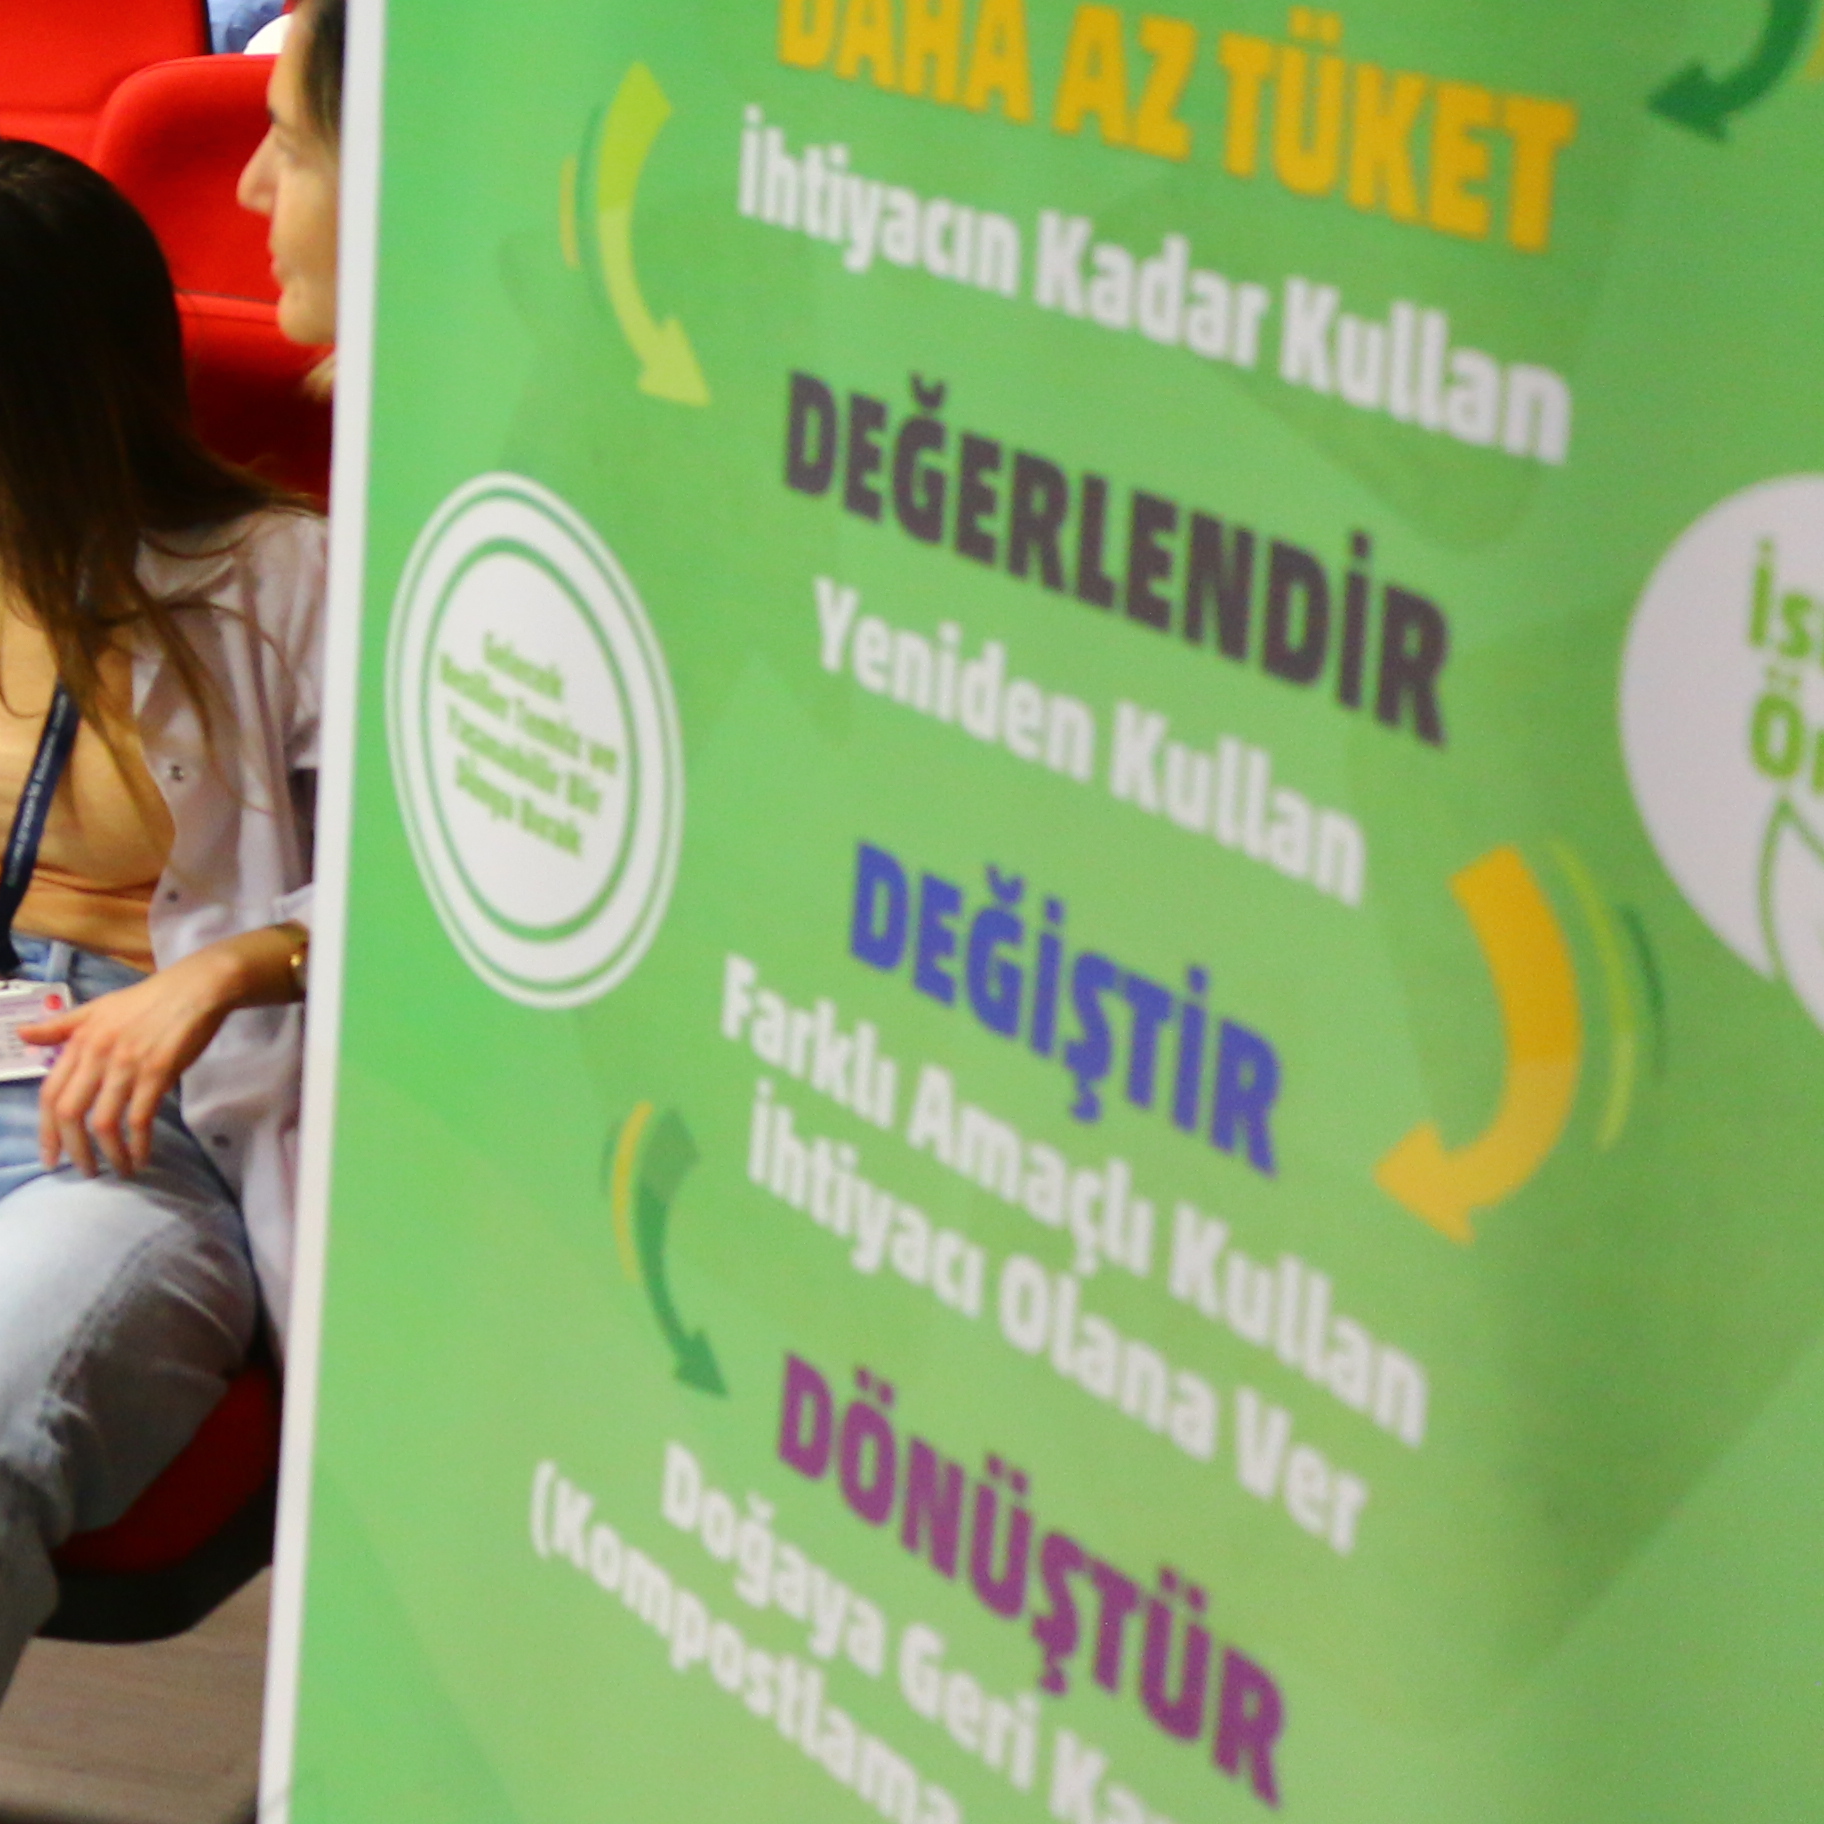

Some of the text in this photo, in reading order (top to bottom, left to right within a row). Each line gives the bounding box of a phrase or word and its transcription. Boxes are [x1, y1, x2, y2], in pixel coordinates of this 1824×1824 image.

[736, 102, 1571, 467] İhtiyacın Kadar Kullan
[1052, 0, 1200, 161] AZ
[1217, 4, 1581, 254] TÜKET
[782, 366, 1450, 751] DEĞERLENDİR
[811, 572, 1097, 785] Yeniden
[1106, 696, 1367, 908] Kullan
[849, 836, 1283, 1179] DEĞİŞTİR
[720, 950, 1428, 1450] Farklı Amaçlı Kullan
[747, 1077, 1368, 1559] İhtiyacı Olana Ver
[661, 1438, 885, 1678] Doğaya
[896, 1621, 1040, 1792] Geri
[776, 1348, 1286, 1812] DÖNÜŞTÜR
